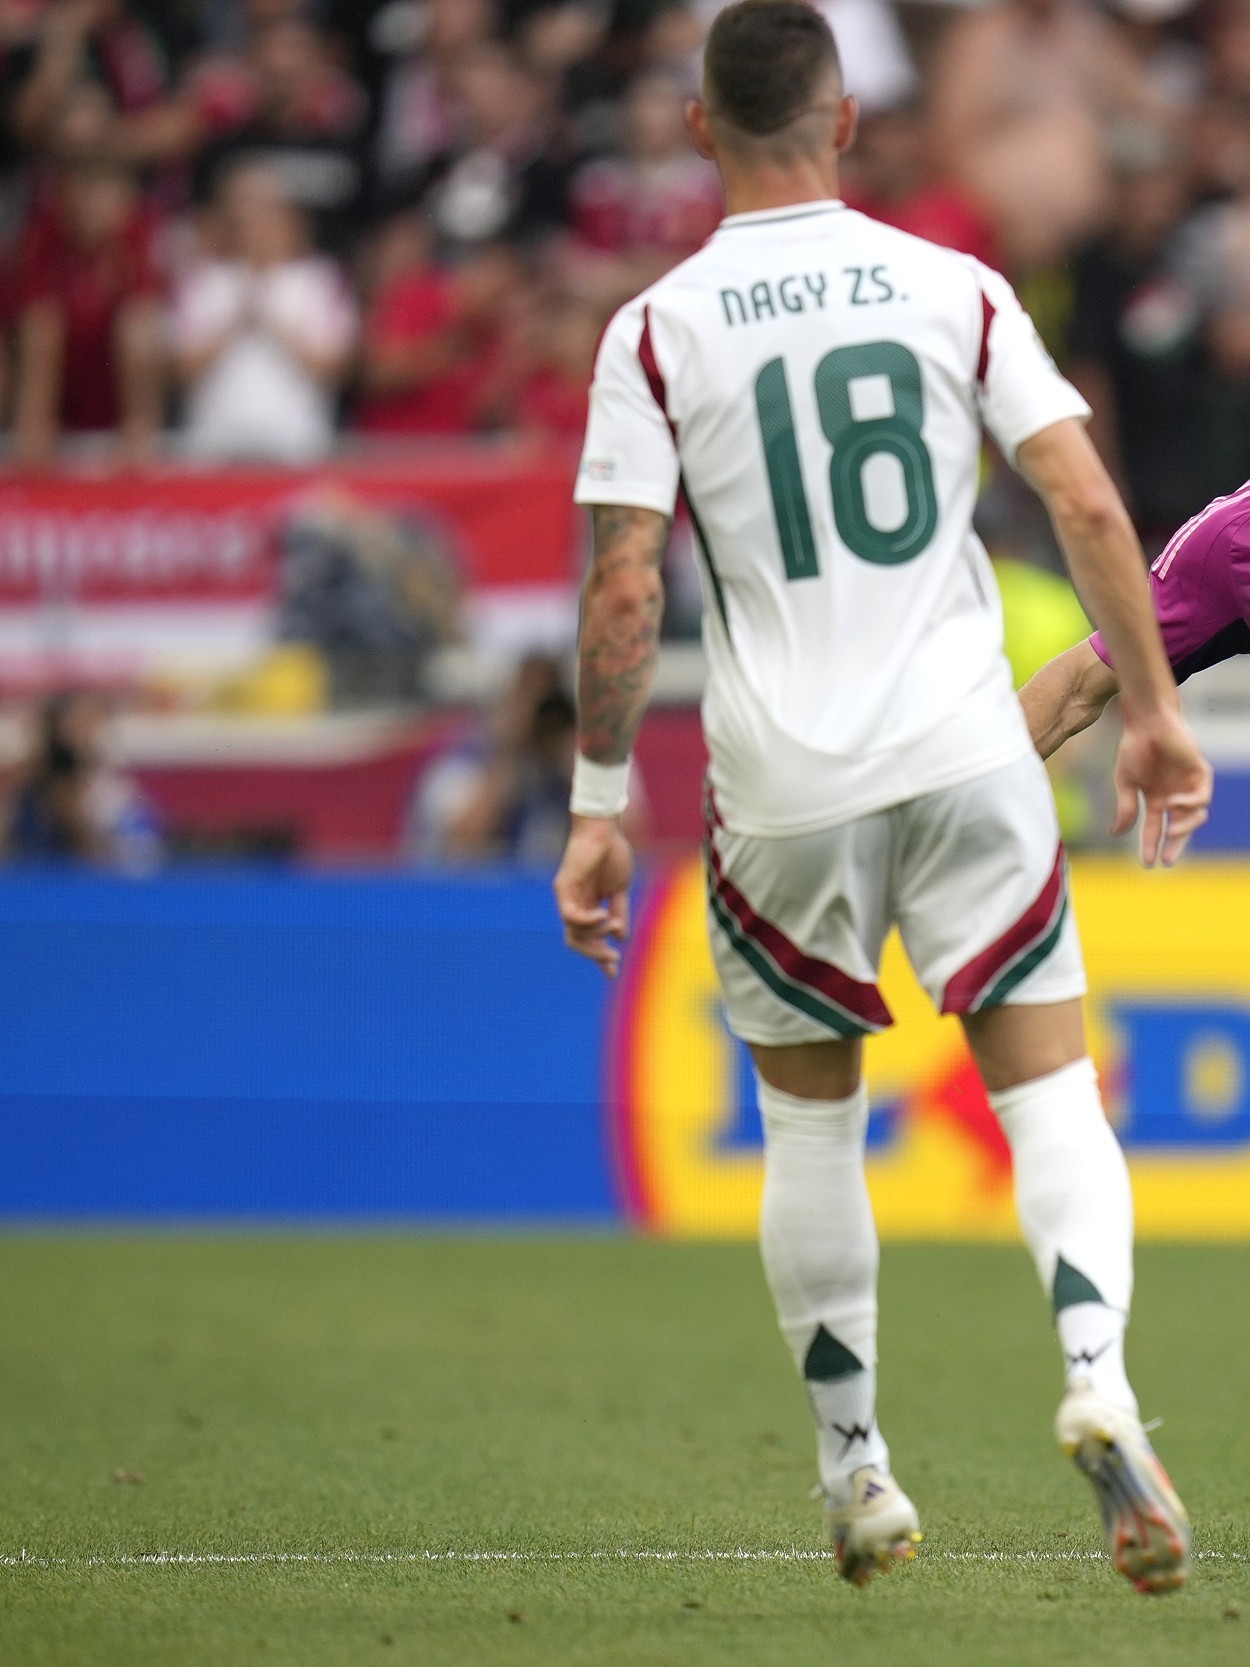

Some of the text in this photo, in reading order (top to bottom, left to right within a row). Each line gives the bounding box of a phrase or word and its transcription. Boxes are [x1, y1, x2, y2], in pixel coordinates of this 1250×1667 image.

[720, 264, 908, 326] NAGY ZS.
[755, 340, 938, 581] 18
